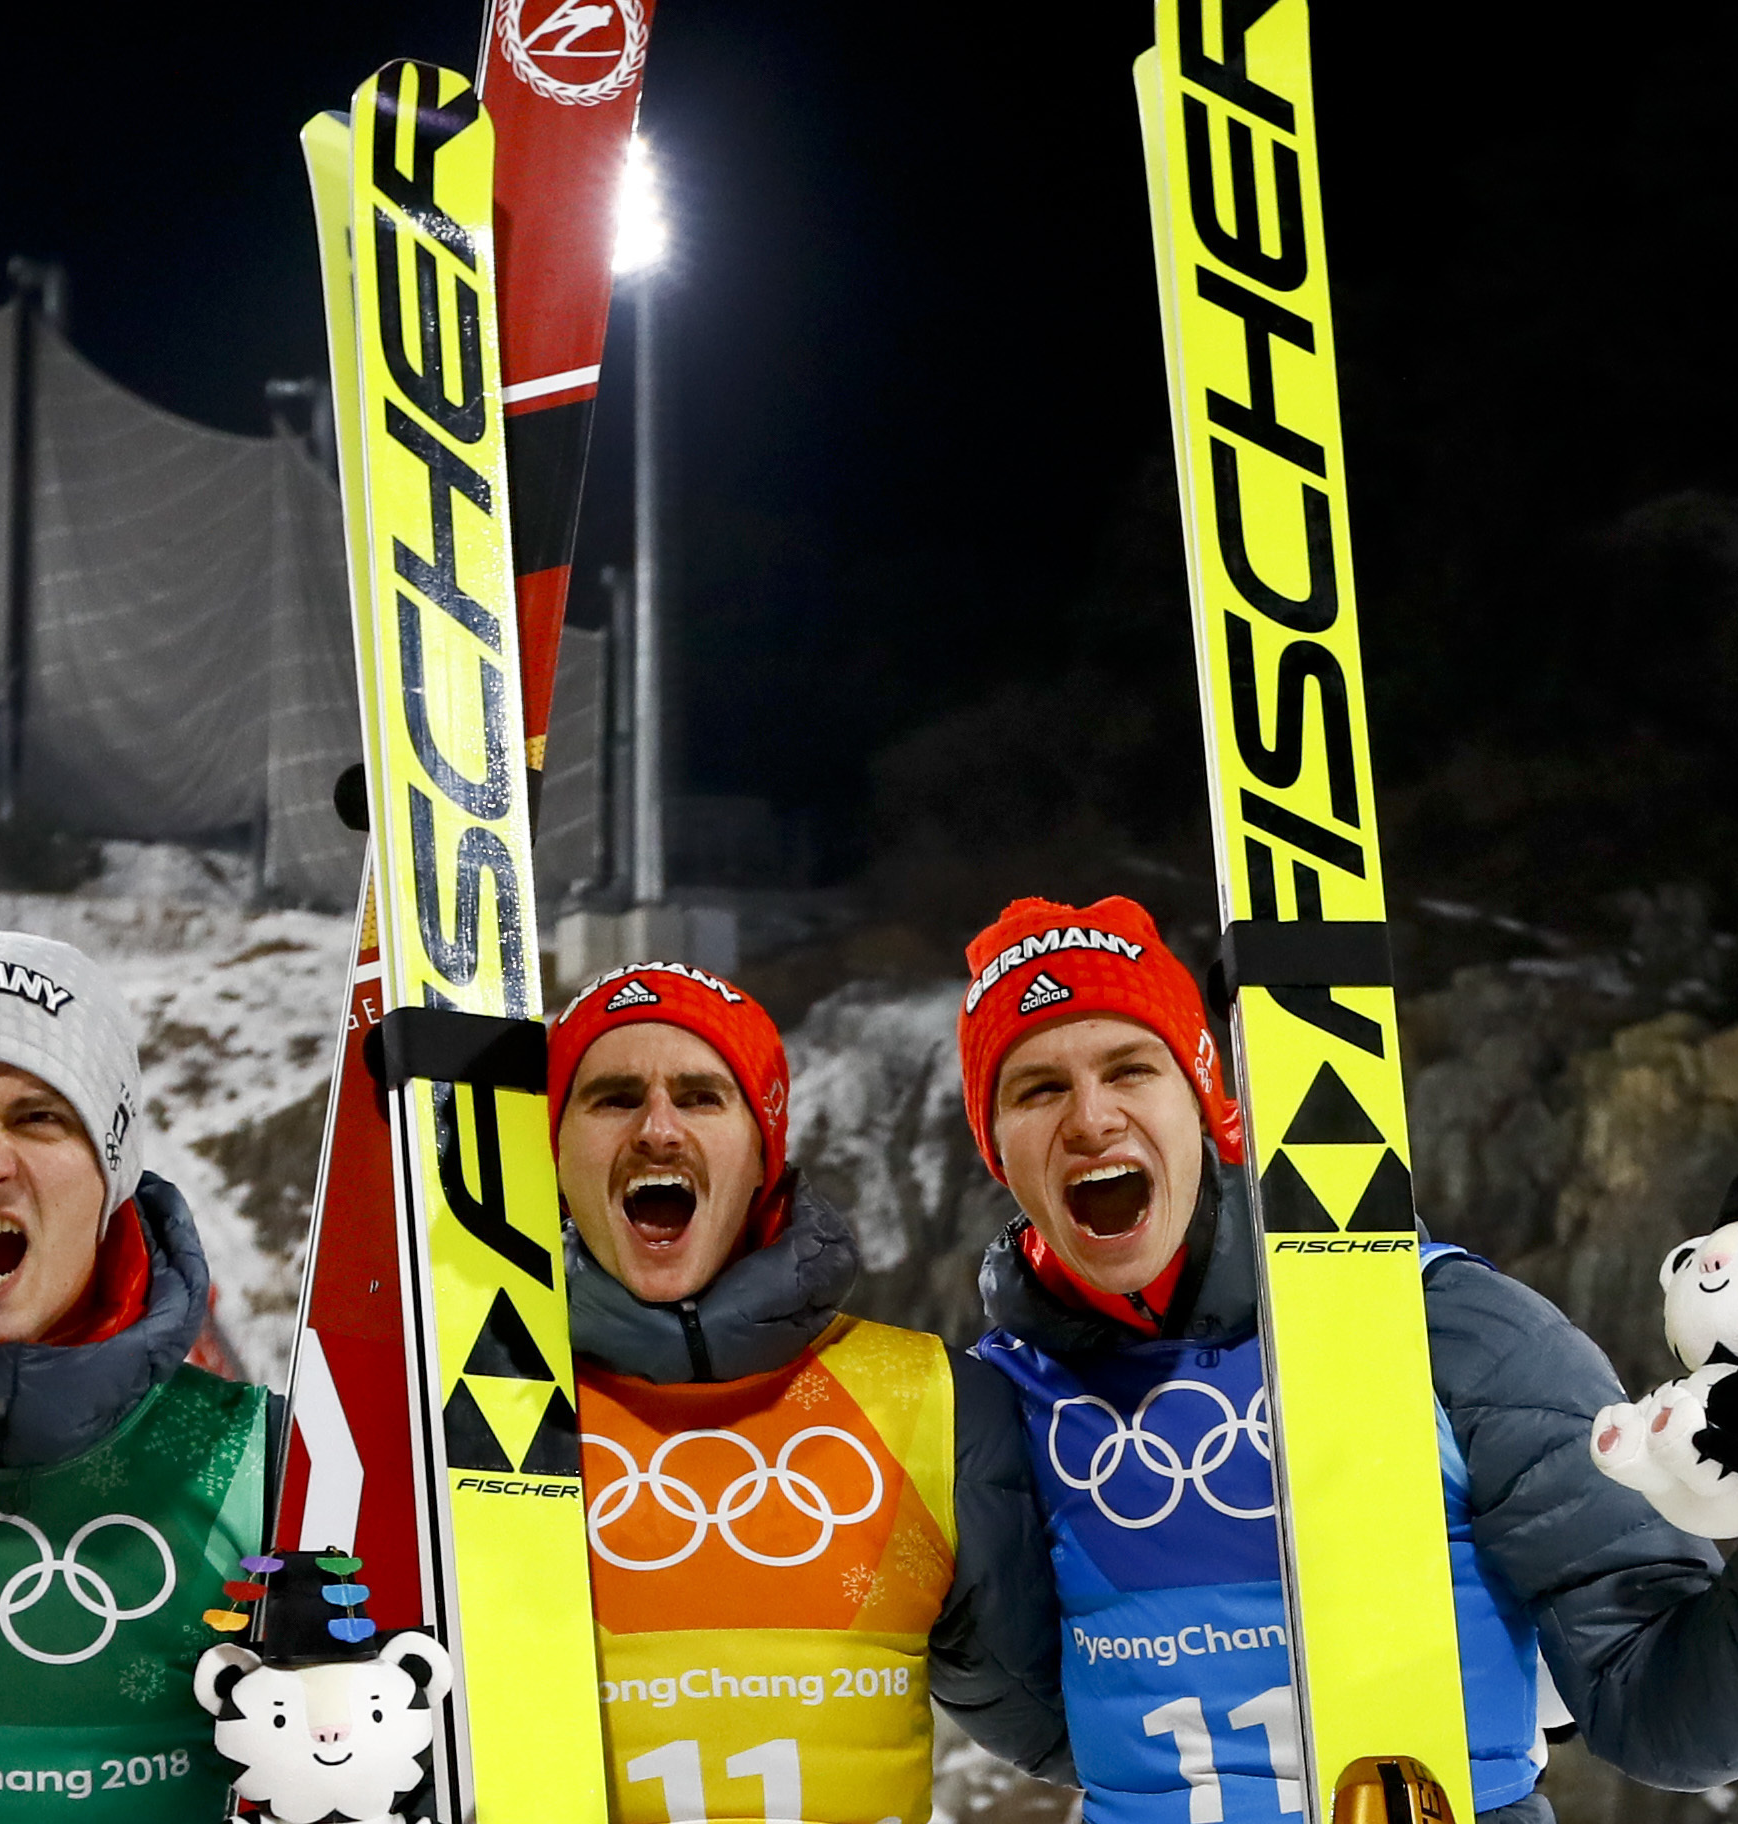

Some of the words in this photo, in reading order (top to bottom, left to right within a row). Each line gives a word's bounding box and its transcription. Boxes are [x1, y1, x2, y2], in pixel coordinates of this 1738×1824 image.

[965, 926, 1143, 1015] GERMANY
[607, 993, 657, 1011] adidas
[1020, 987, 1070, 1013] adidas
[1274, 1239, 1415, 1254] FISCHER
[456, 1478, 580, 1499] FISCHER
[1072, 1623, 1287, 1667] PyeongChan
[830, 1667, 910, 1698] 2018
[101, 1749, 191, 1790] 2018
[1142, 1685, 1303, 1824] 11
